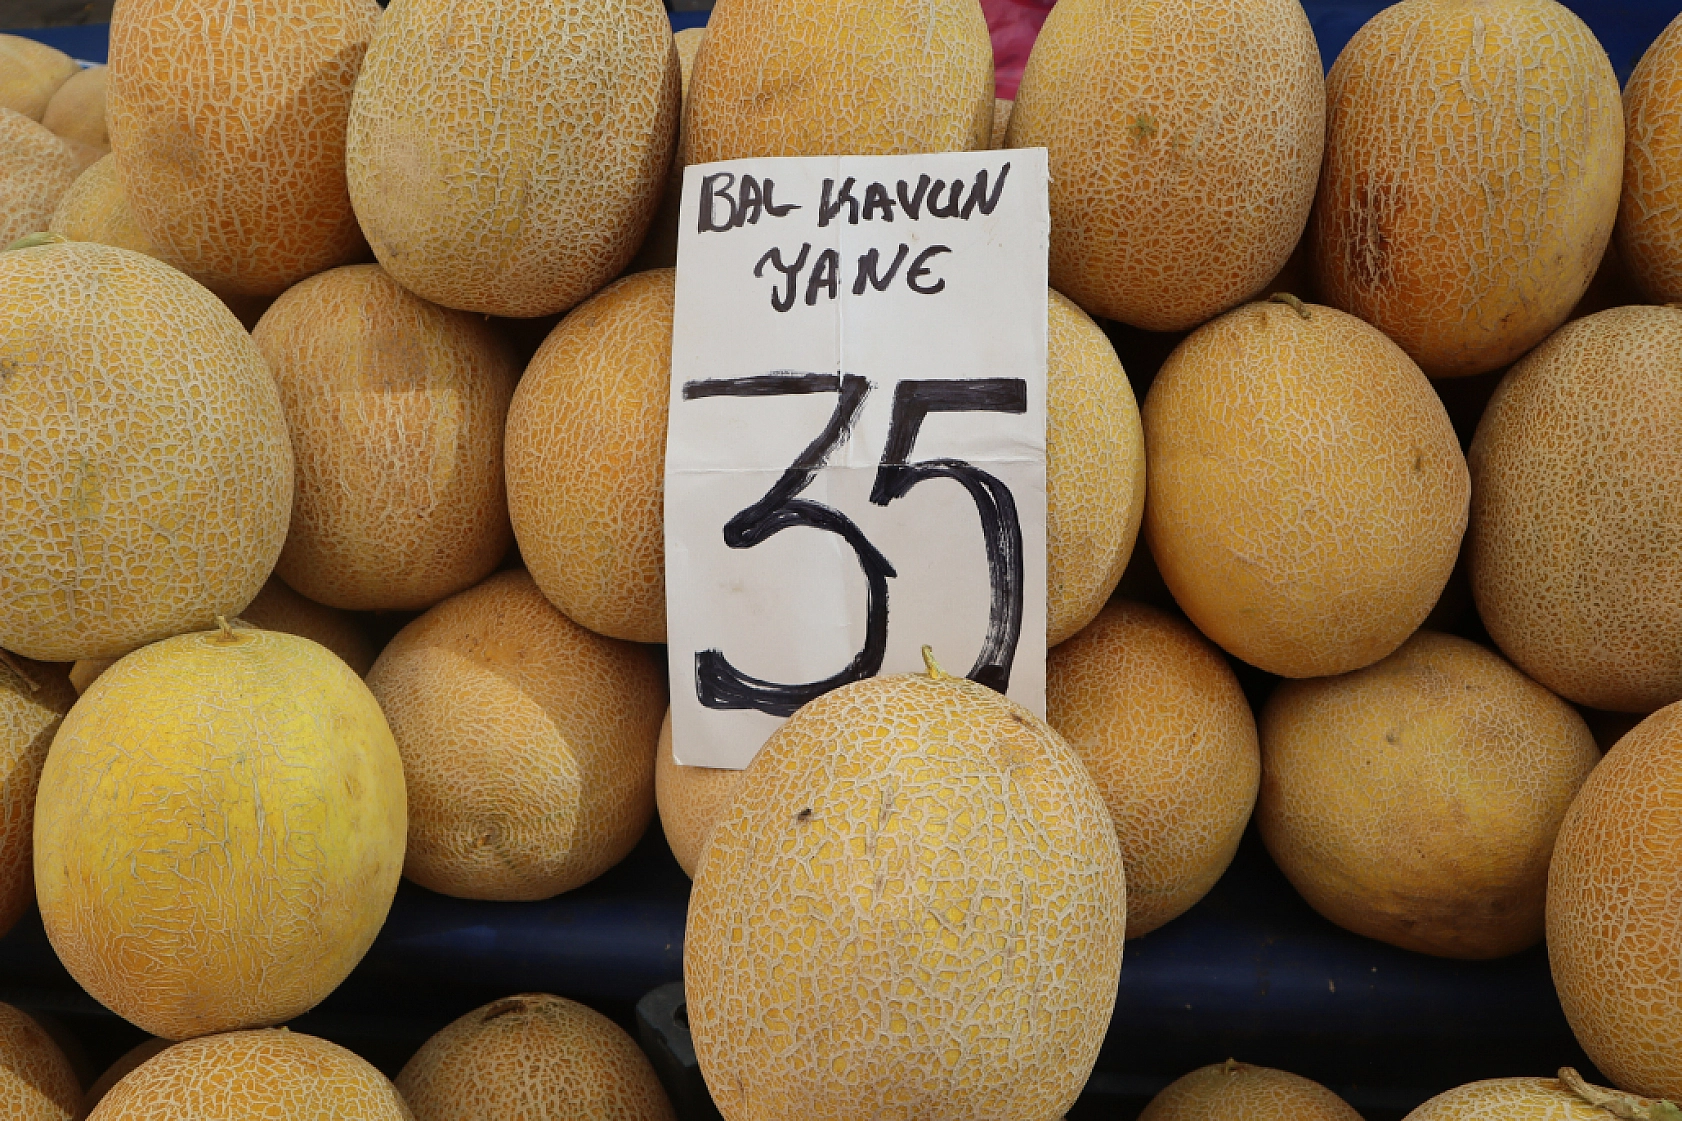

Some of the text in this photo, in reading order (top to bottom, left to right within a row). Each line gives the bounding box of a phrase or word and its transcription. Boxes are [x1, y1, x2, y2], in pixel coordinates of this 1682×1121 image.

[697, 161, 1011, 235] BAL KAVUN
[682, 370, 1028, 717] 35
